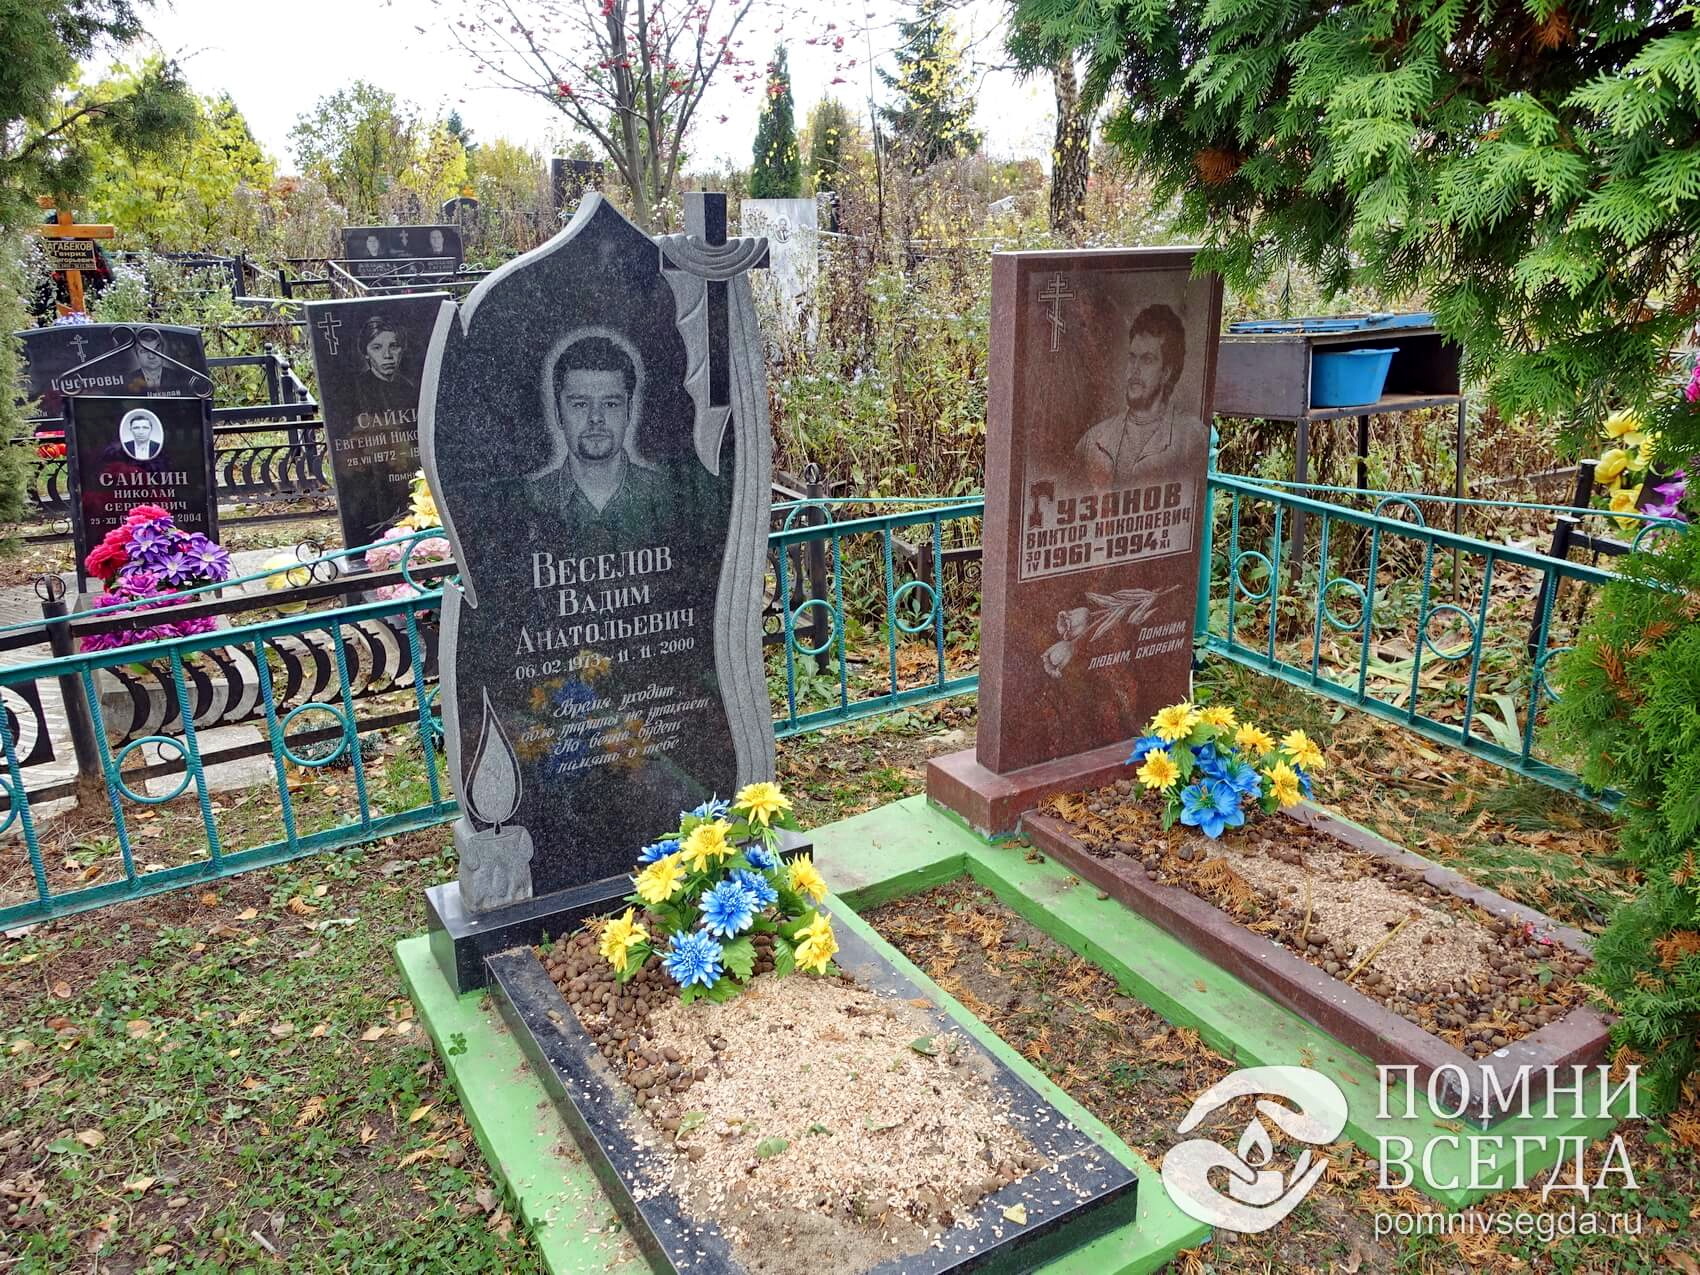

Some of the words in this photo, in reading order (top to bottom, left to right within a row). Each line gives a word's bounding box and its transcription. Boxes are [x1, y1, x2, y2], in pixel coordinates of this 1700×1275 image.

[335, 432, 387, 451] ЕВГЕНИЙ
[99, 470, 190, 487] САЙКИН
[113, 488, 176, 499] НИКОЛАЙ
[1026, 524, 1088, 550] ВИКТОР
[1094, 507, 1191, 538] НИКОЛАЕВИЧ
[532, 546, 672, 590] ВЕСЕЛОВ
[558, 585, 652, 617] ВАДИМ
[514, 607, 695, 655] АНАТОЛЬЕВИЧ
[1134, 637, 1185, 660] СКОРБИМ
